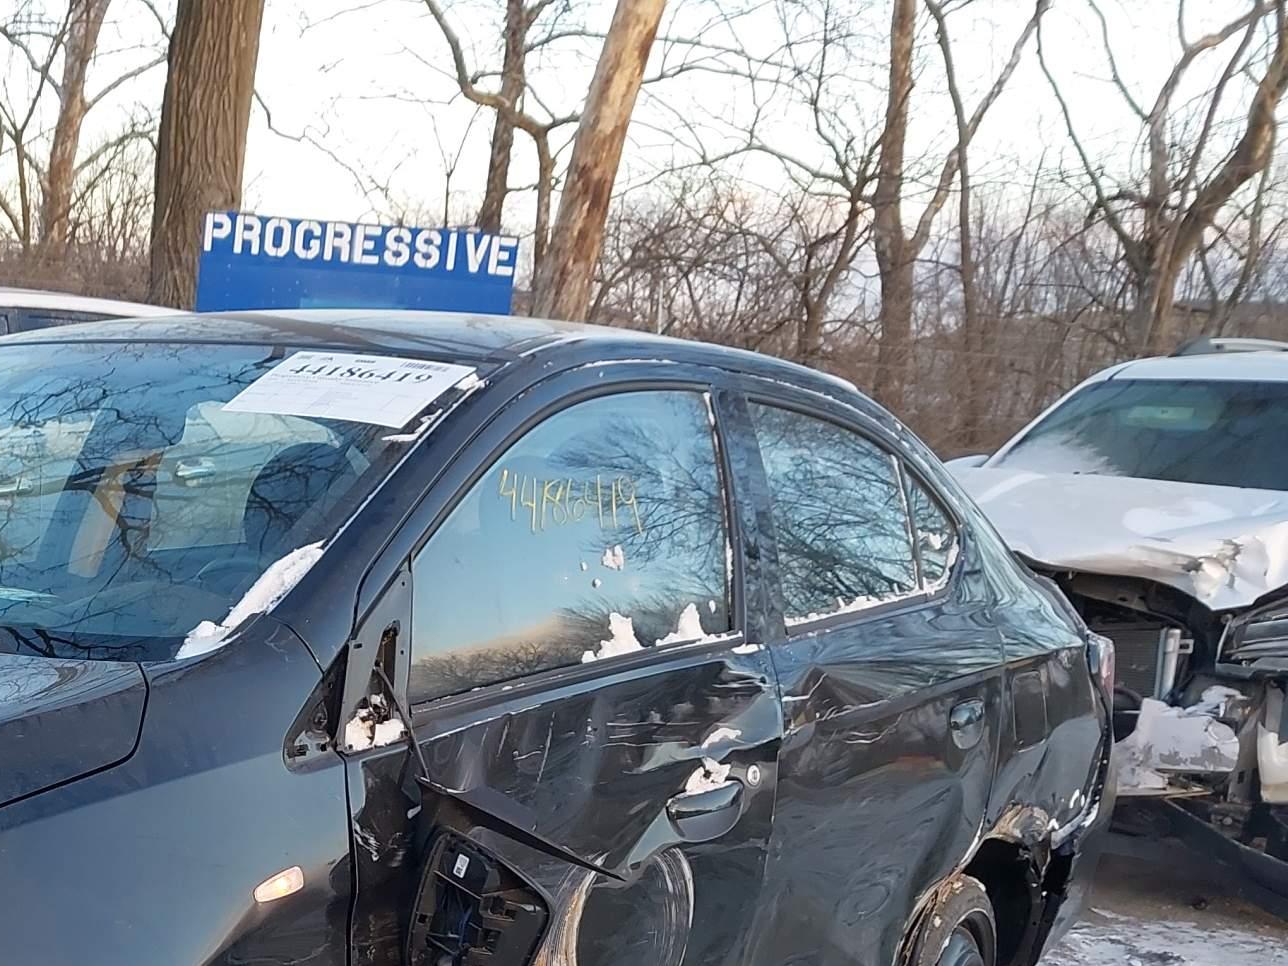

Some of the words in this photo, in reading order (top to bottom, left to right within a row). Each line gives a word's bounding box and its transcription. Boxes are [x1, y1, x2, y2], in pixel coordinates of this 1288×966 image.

[203, 212, 518, 276] PROGRESSIVE
[290, 364, 432, 383] 44186419
[500, 469, 643, 535] 44186419
